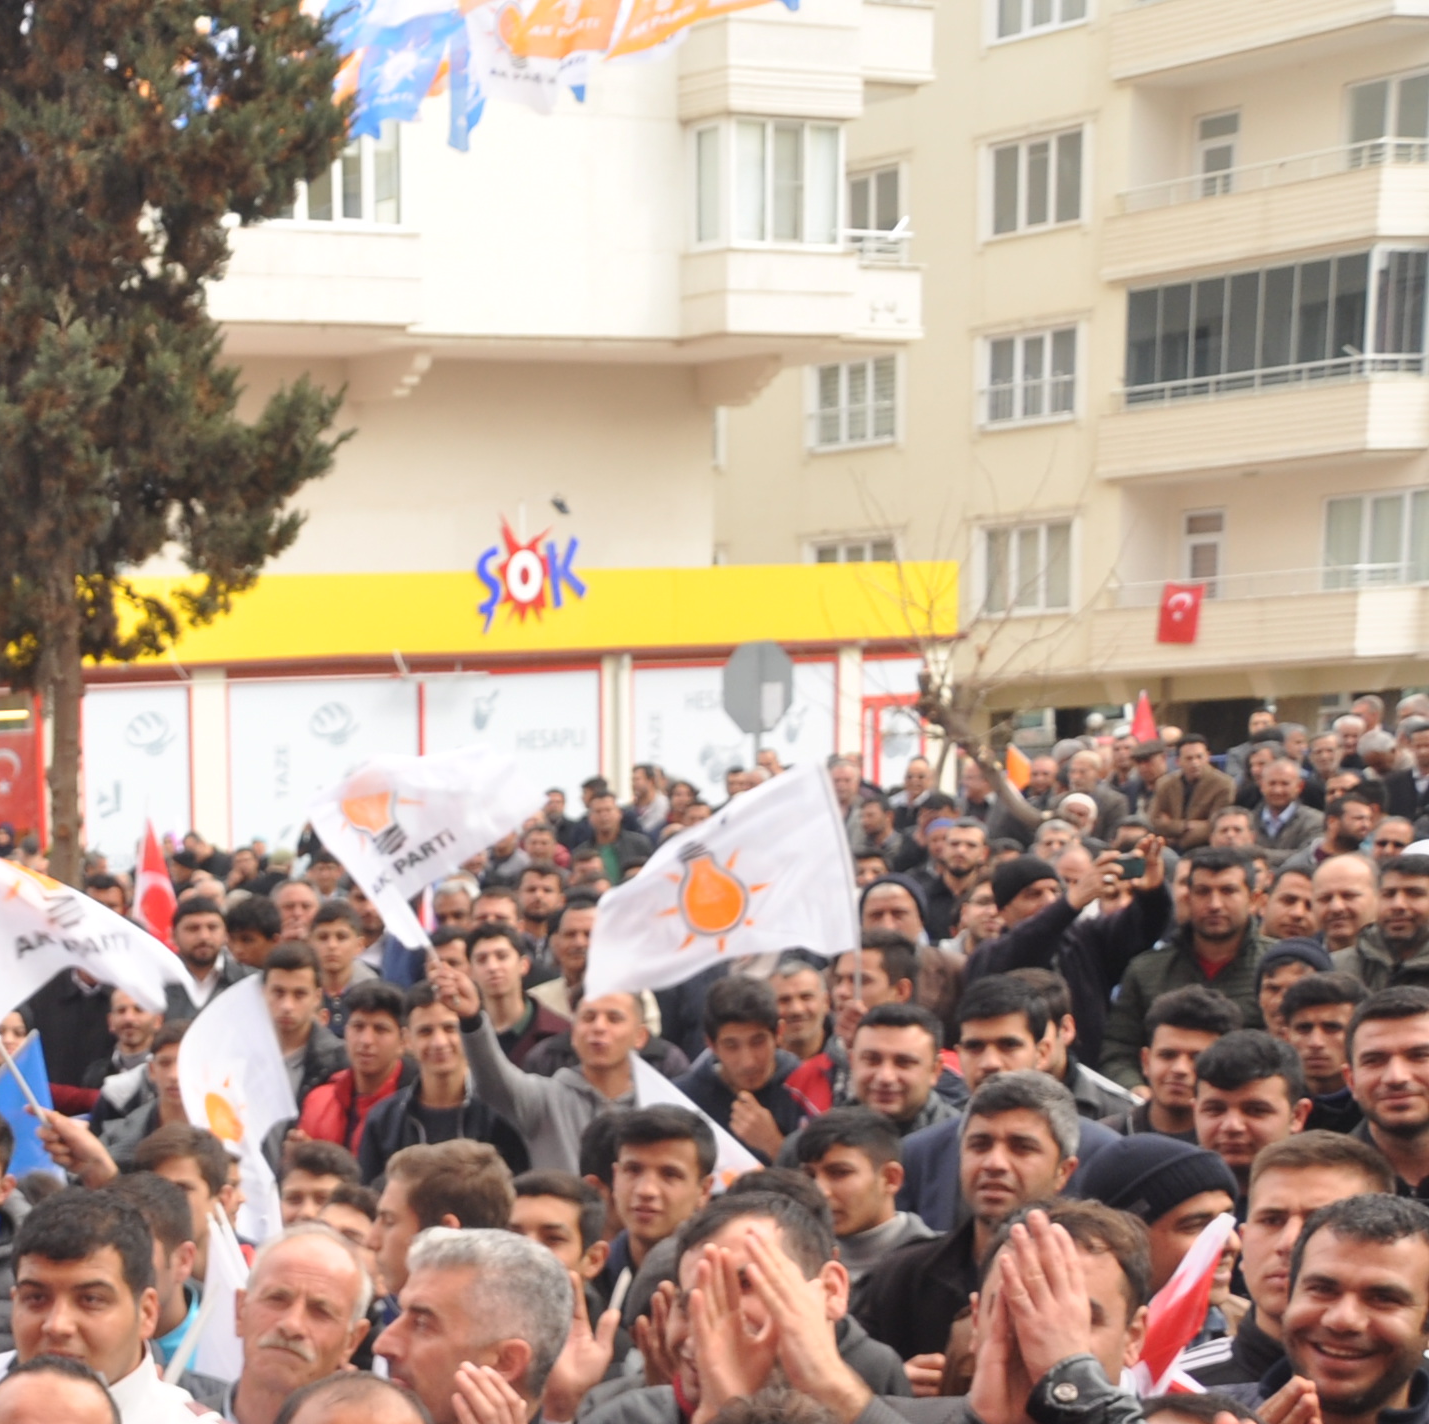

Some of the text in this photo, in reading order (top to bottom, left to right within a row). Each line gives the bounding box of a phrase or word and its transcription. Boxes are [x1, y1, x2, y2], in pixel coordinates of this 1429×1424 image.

[477, 534, 587, 634] ŞOK
[515, 727, 586, 751] HESAPLI
[274, 743, 291, 799] TAZE
